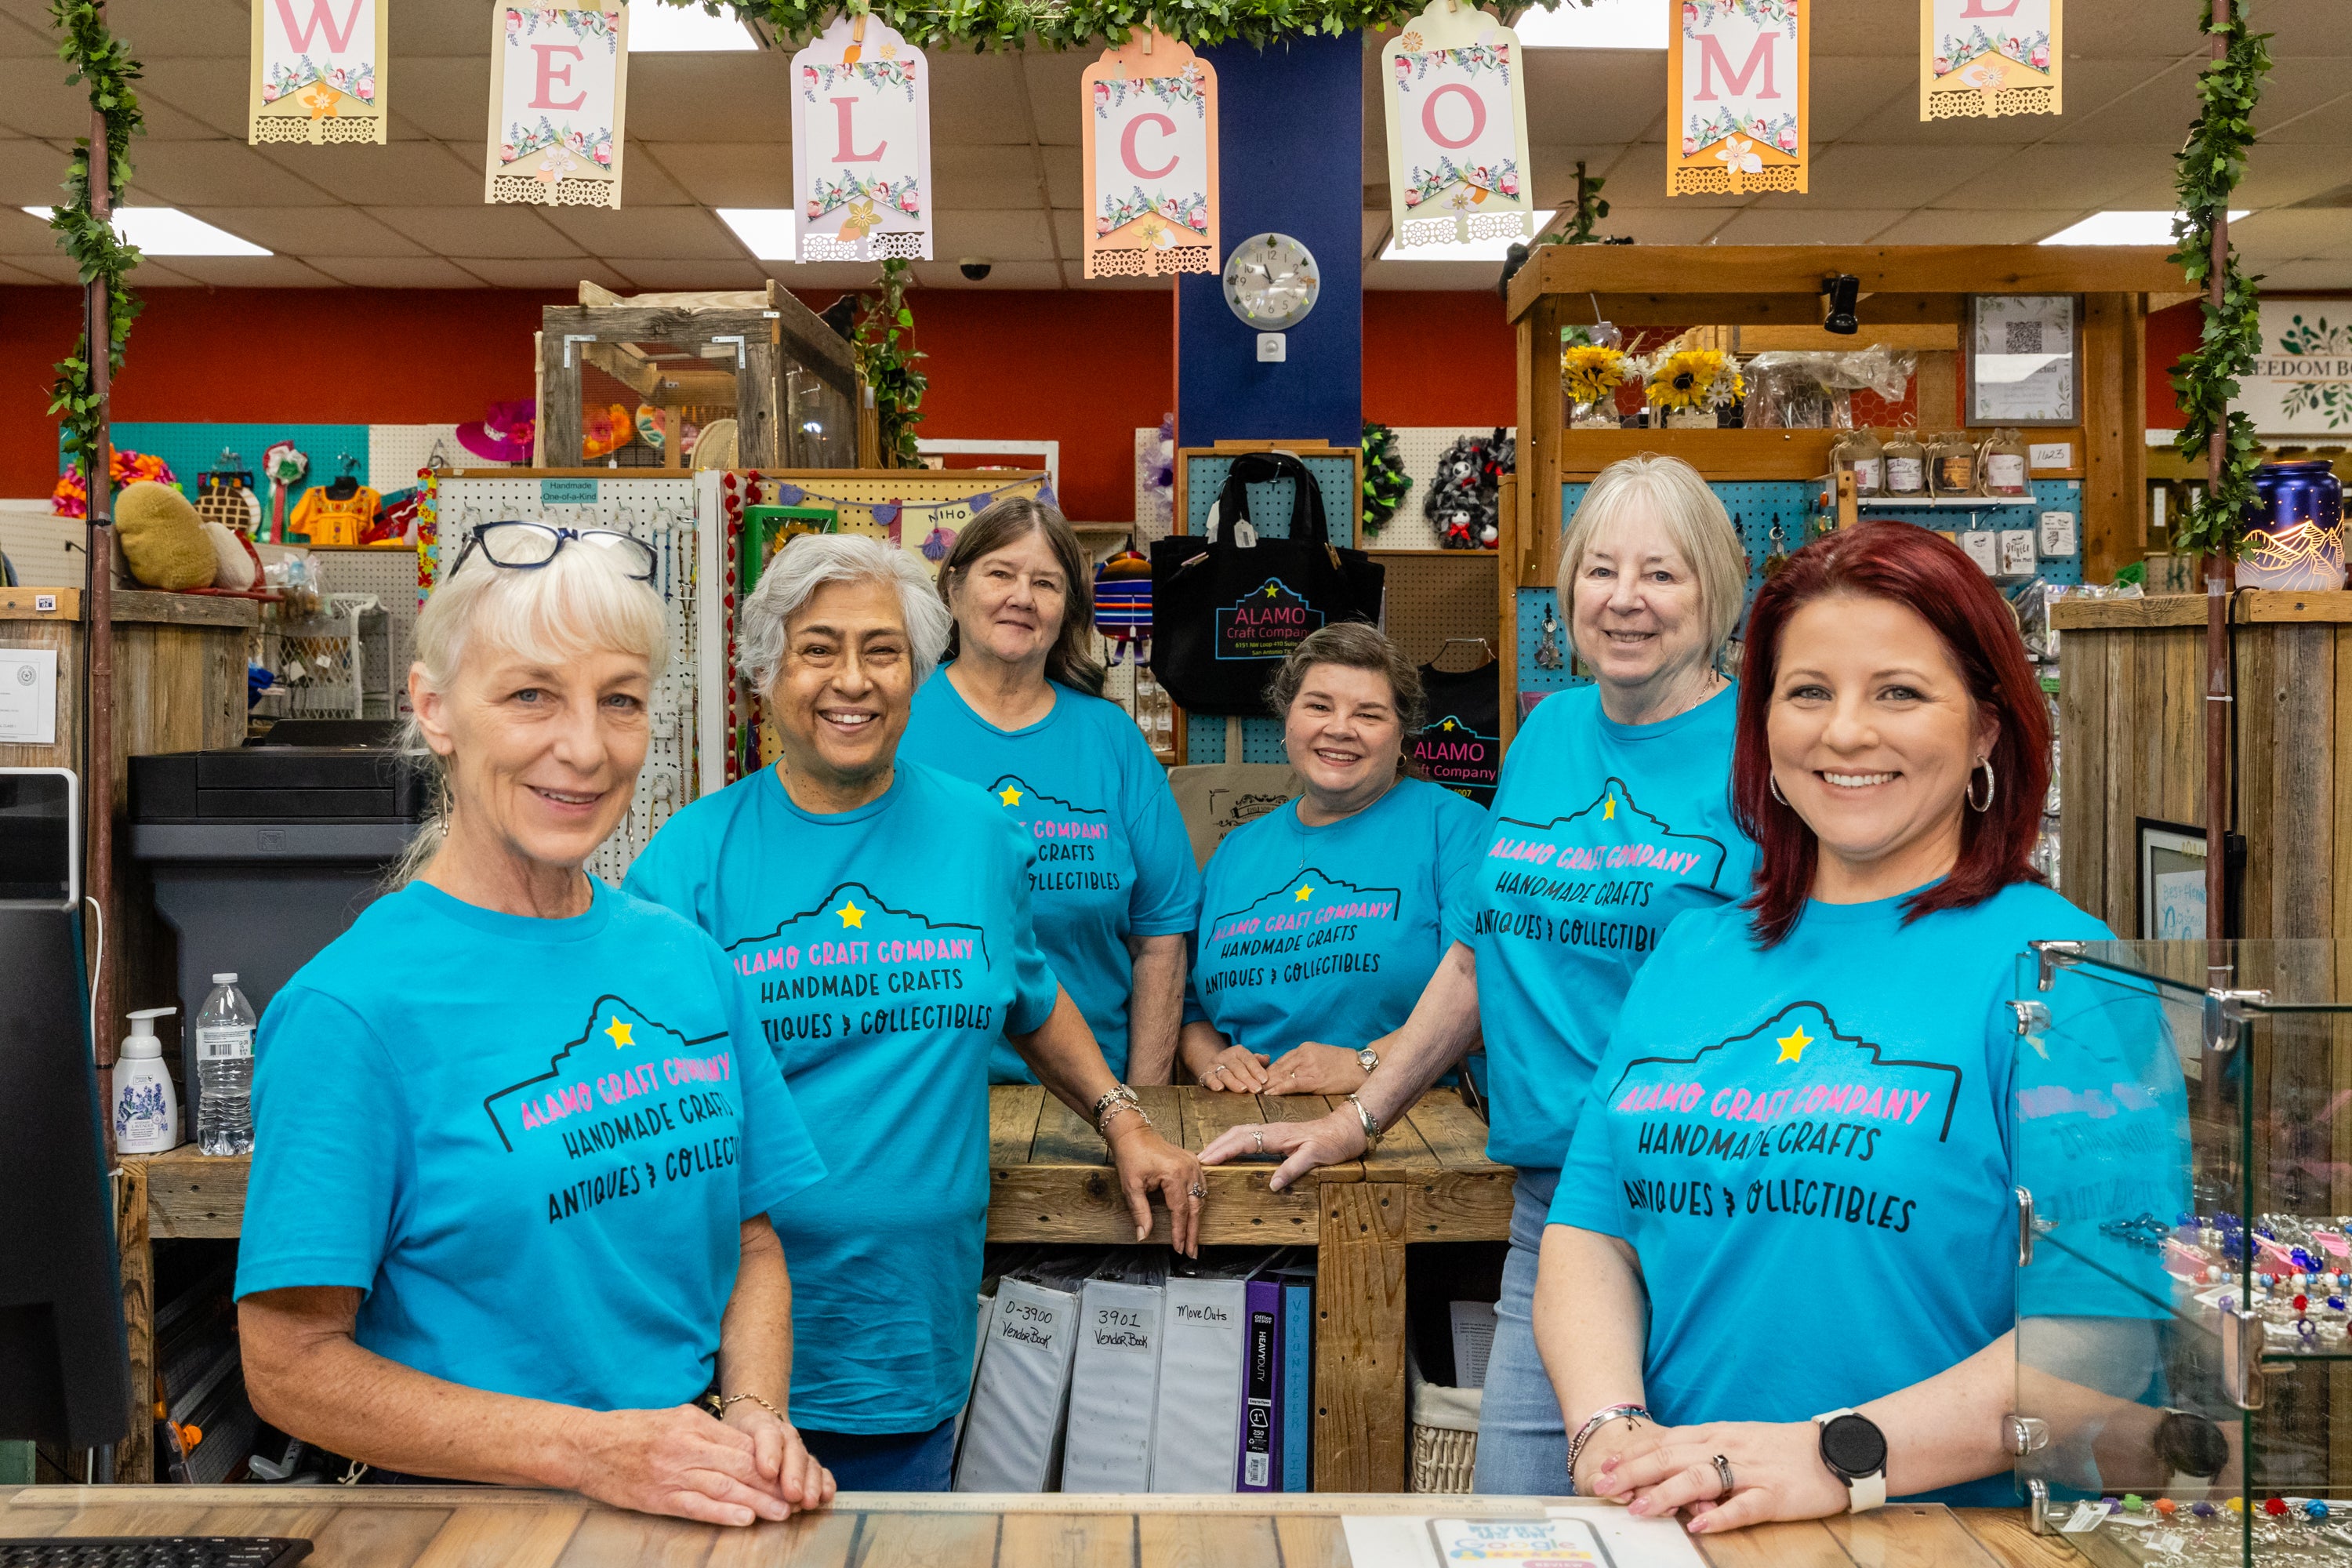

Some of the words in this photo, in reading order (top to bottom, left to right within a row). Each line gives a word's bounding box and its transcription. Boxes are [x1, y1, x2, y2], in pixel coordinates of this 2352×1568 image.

[1268, 250, 1277, 260] 12
[1293, 263, 1299, 275] 2
[1240, 277, 1247, 286] 9
[1269, 304, 1275, 314] 6
[1282, 300, 1289, 310] 5
[2255, 360, 2330, 376] EEDOM
[2337, 360, 2352, 376] B
[1235, 607, 1305, 625] ALAMO
[1227, 627, 1255, 639] Craft
[1258, 627, 1309, 639] Compan
[1414, 741, 1484, 761] ALAMO
[1434, 765, 1496, 781] Company
[1034, 820, 1108, 840] COMPANY
[1039, 843, 1094, 862] CRAFTS
[1489, 837, 1557, 866] ALAMO
[1556, 846, 1607, 871] CRAFT
[1606, 843, 1700, 876] COMPANY
[1028, 871, 1120, 891] OLLECTIBLES
[1495, 871, 1596, 903] HANDMADE
[1595, 880, 1653, 908] CRAFTS
[1213, 917, 1261, 942] ALAMO
[1265, 910, 1312, 932] CRAFT
[1315, 902, 1392, 925] COMPANY
[1475, 909, 1541, 941] ANTIQUES
[1560, 918, 1654, 953] COLLECTIBL
[808, 942, 869, 966] CRAFT
[877, 938, 973, 964] COMPANY
[1221, 935, 1303, 960] HANDMADE
[1307, 924, 1358, 949] CRAFTS
[1206, 967, 1265, 996] ANTIQUES
[1284, 953, 1381, 984] COLLECTIBLES
[761, 972, 880, 1004] HANDMADE
[887, 968, 963, 993] CRAFTS
[761, 1013, 832, 1044] TIQUES
[861, 1004, 992, 1035] COLLECTIBLES
[521, 1082, 593, 1131] ALAMO
[597, 1062, 659, 1105] CRAFT
[1617, 1082, 1705, 1113] ALAMO
[1710, 1088, 1793, 1123] CRAFT
[1791, 1084, 1931, 1125] COMPANY
[562, 1102, 675, 1160] HANDMADE
[679, 1091, 734, 1123] CRAFTS
[1638, 1121, 1777, 1161] HANDMADE
[1777, 1121, 1882, 1161] CRAFTS
[549, 1164, 640, 1224] ANTIQUES
[1746, 1178, 1917, 1233] OLLECTIBLES
[1098, 1310, 1141, 1328] 3901
[1177, 1305, 1202, 1320] Move
[1203, 1306, 1227, 1321] Outs
[1454, 1537, 1577, 1551] Google
